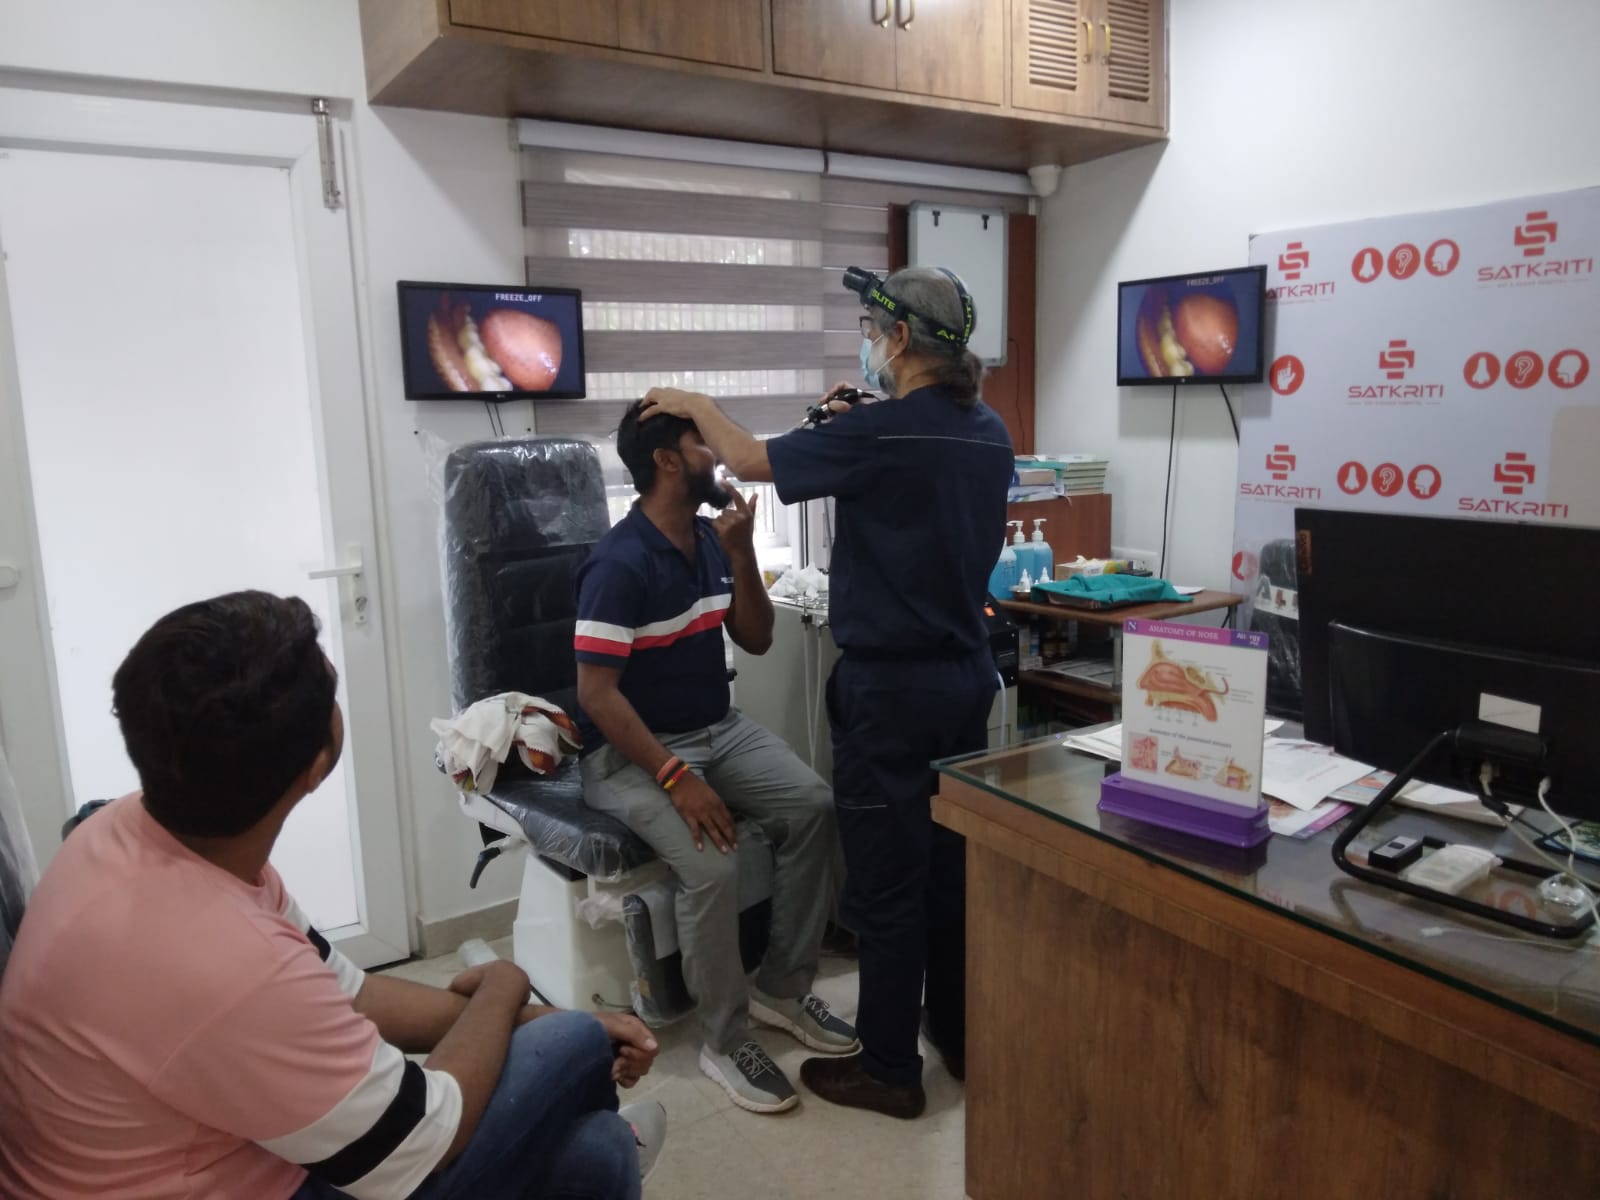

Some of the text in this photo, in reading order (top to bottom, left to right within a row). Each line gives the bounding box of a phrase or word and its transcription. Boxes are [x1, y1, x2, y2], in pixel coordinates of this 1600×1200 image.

[1477, 257, 1593, 282] SATKRITI
[495, 293, 543, 303] FREEZE_OFF
[1266, 280, 1335, 300] ATKRITI
[1348, 384, 1444, 399] SATKRITI
[1240, 482, 1322, 500] SATKRITI
[1458, 497, 1569, 519] SATKRITI
[1148, 625, 1219, 641] ANATOMY OF NOSE
